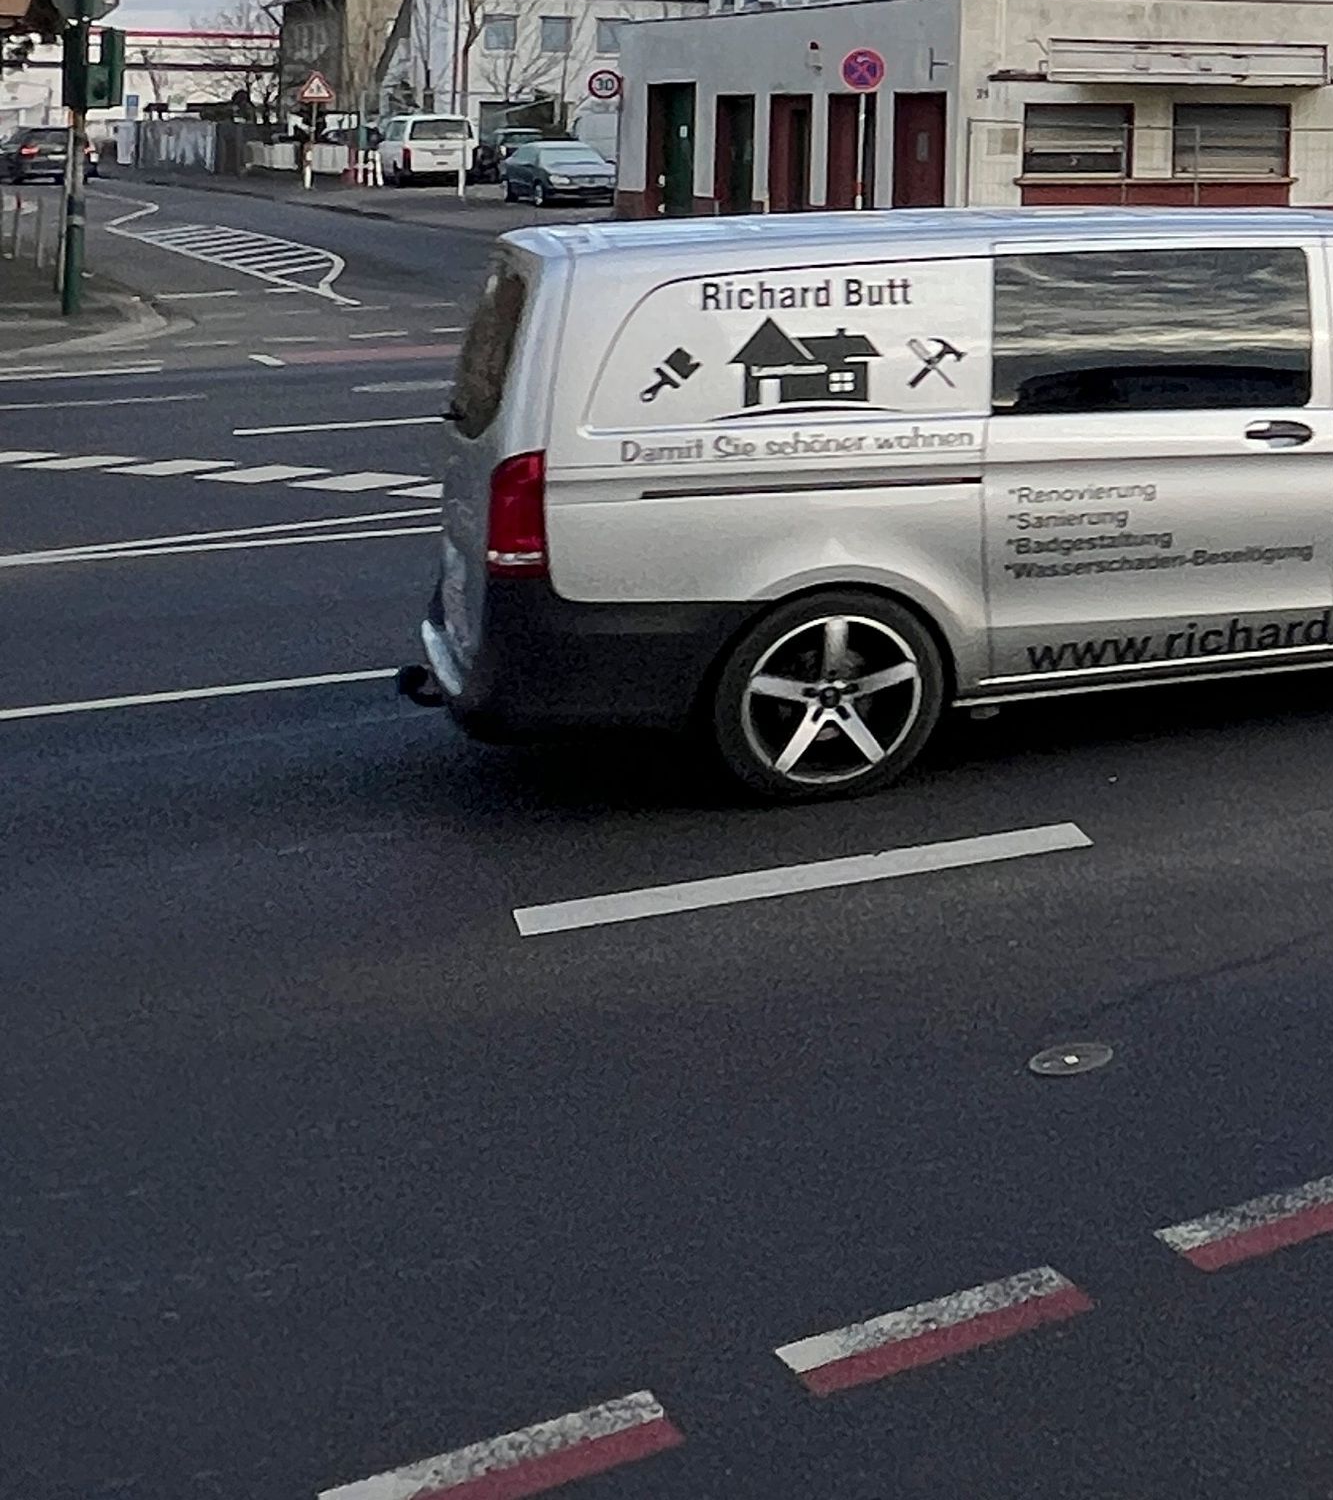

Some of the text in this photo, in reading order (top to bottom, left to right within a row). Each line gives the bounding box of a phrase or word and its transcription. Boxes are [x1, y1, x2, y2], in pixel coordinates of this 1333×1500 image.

[594, 77, 615, 92] 30
[701, 278, 913, 311] Richard Butt
[620, 426, 975, 462] Damit Sie schöner wohnen
[1015, 483, 1157, 503] Renovierung
[1015, 509, 1130, 530] Sanierung
